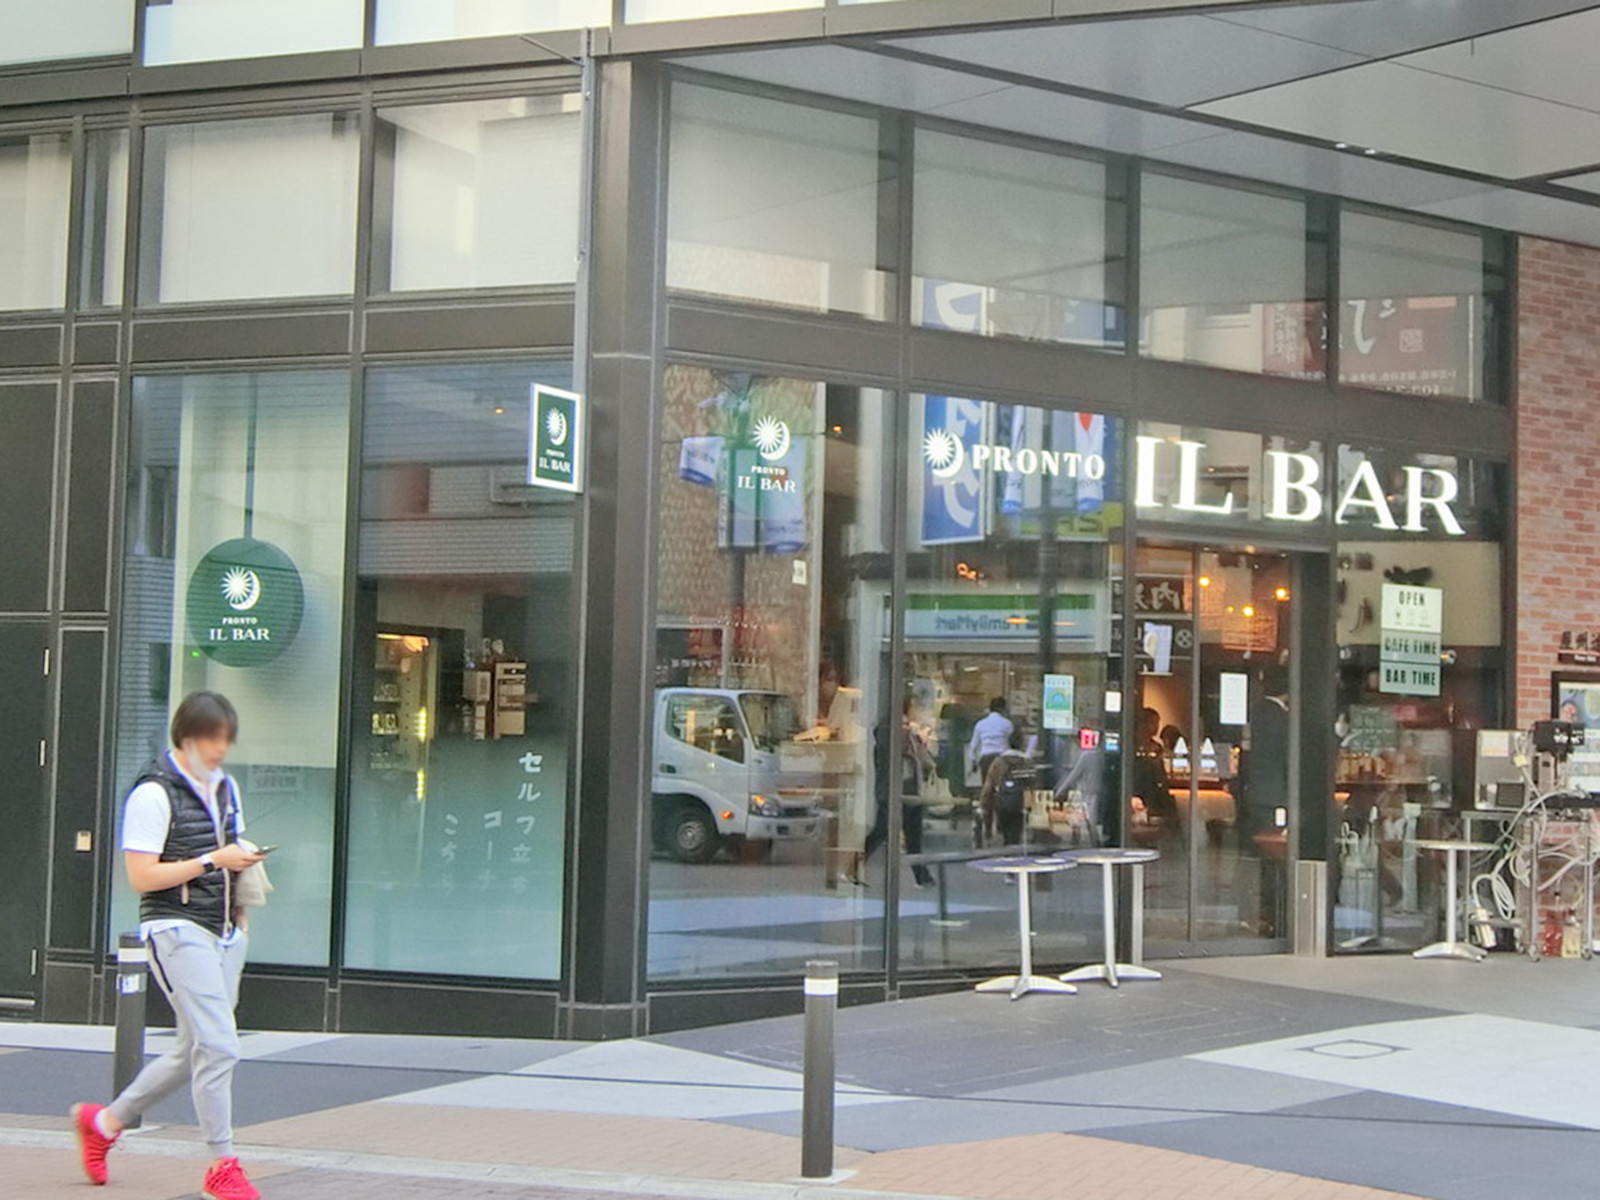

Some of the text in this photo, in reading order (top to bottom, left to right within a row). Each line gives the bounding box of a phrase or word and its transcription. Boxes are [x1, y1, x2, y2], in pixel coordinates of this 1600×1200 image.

[751, 465, 786, 476] PRONTO
[972, 444, 1106, 480] PRONTO
[738, 476, 797, 493] IL BAR
[1134, 436, 1233, 514] IL
[1265, 450, 1466, 535] BAR
[1398, 590, 1425, 606] OPEN
[210, 628, 270, 641] IL BAR
[1384, 637, 1436, 655] CAFE TIME
[1386, 669, 1436, 686] BAR TIME
